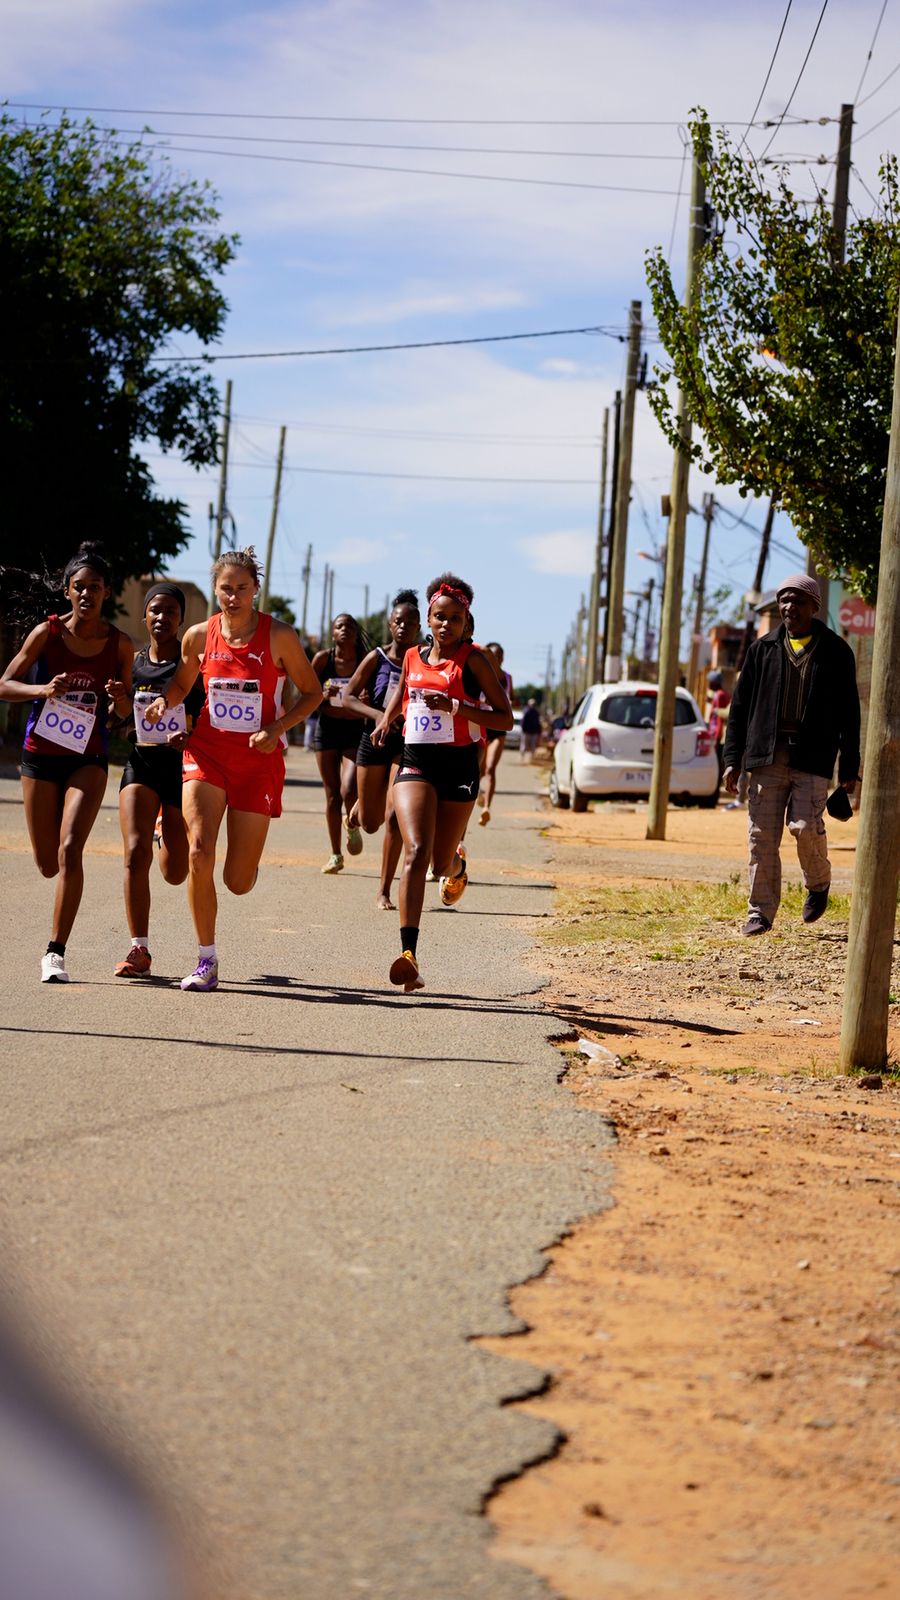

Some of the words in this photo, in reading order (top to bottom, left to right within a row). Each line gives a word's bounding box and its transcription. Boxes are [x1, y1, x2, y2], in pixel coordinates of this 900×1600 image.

[214, 703, 255, 721] 005
[45, 712, 86, 740] 008
[413, 715, 442, 732] 193
